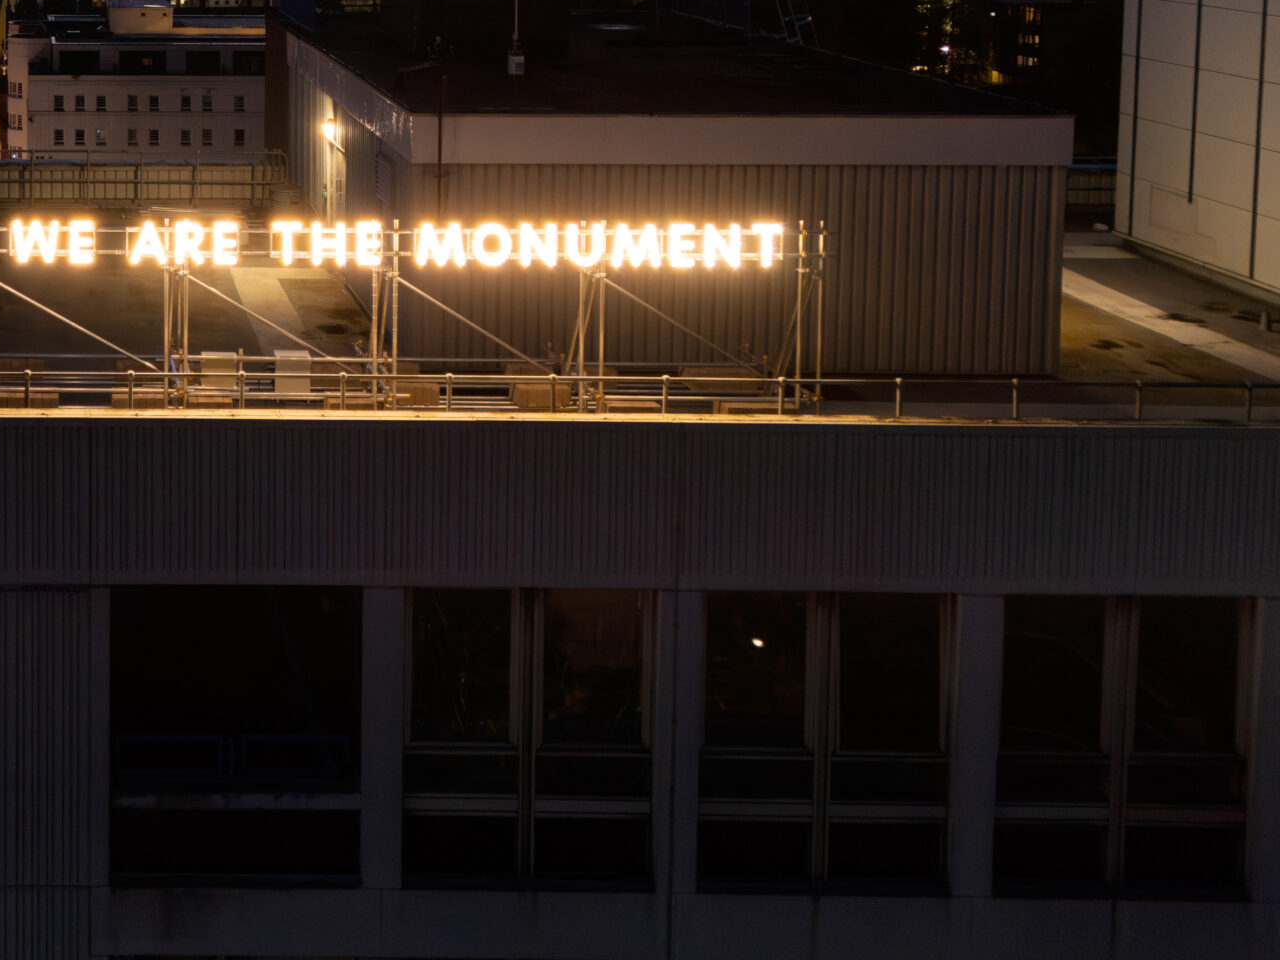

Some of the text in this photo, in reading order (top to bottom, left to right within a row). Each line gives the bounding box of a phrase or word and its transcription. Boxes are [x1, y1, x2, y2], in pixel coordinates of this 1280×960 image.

[11, 220, 784, 268] WE ARE THE MONUMENT
